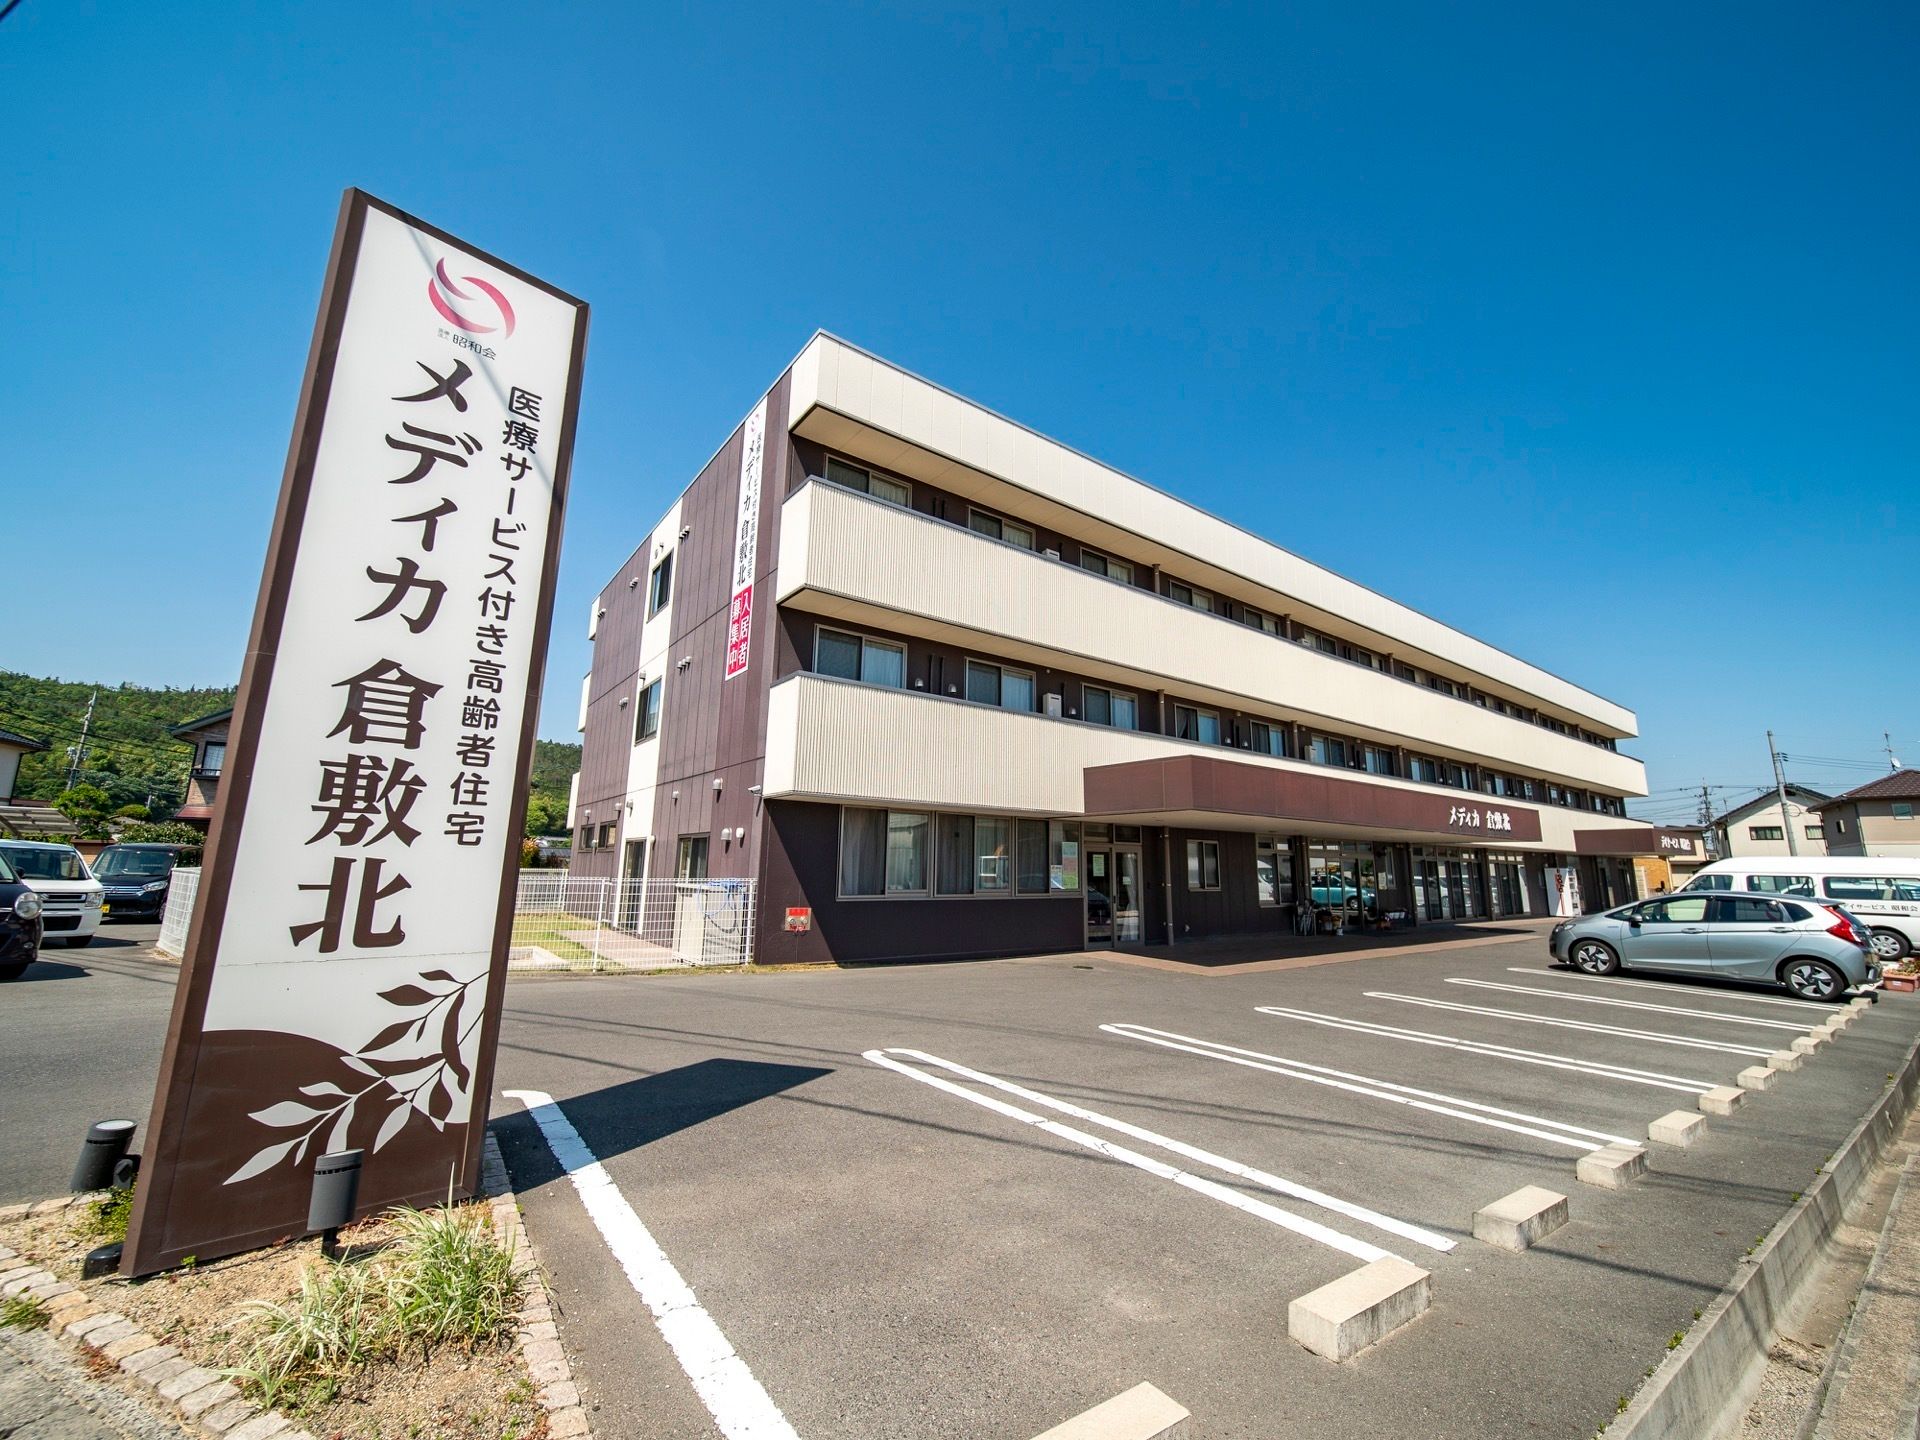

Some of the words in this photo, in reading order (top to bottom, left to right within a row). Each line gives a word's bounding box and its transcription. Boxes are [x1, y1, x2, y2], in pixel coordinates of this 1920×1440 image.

[452, 334, 497, 360] 昭和会
[444, 386, 543, 846] 医療サービス付き高齢者住宅
[739, 592, 751, 665] 入居者
[288, 358, 483, 954] メディカ倉敷北
[1449, 805, 1480, 827] メディカ
